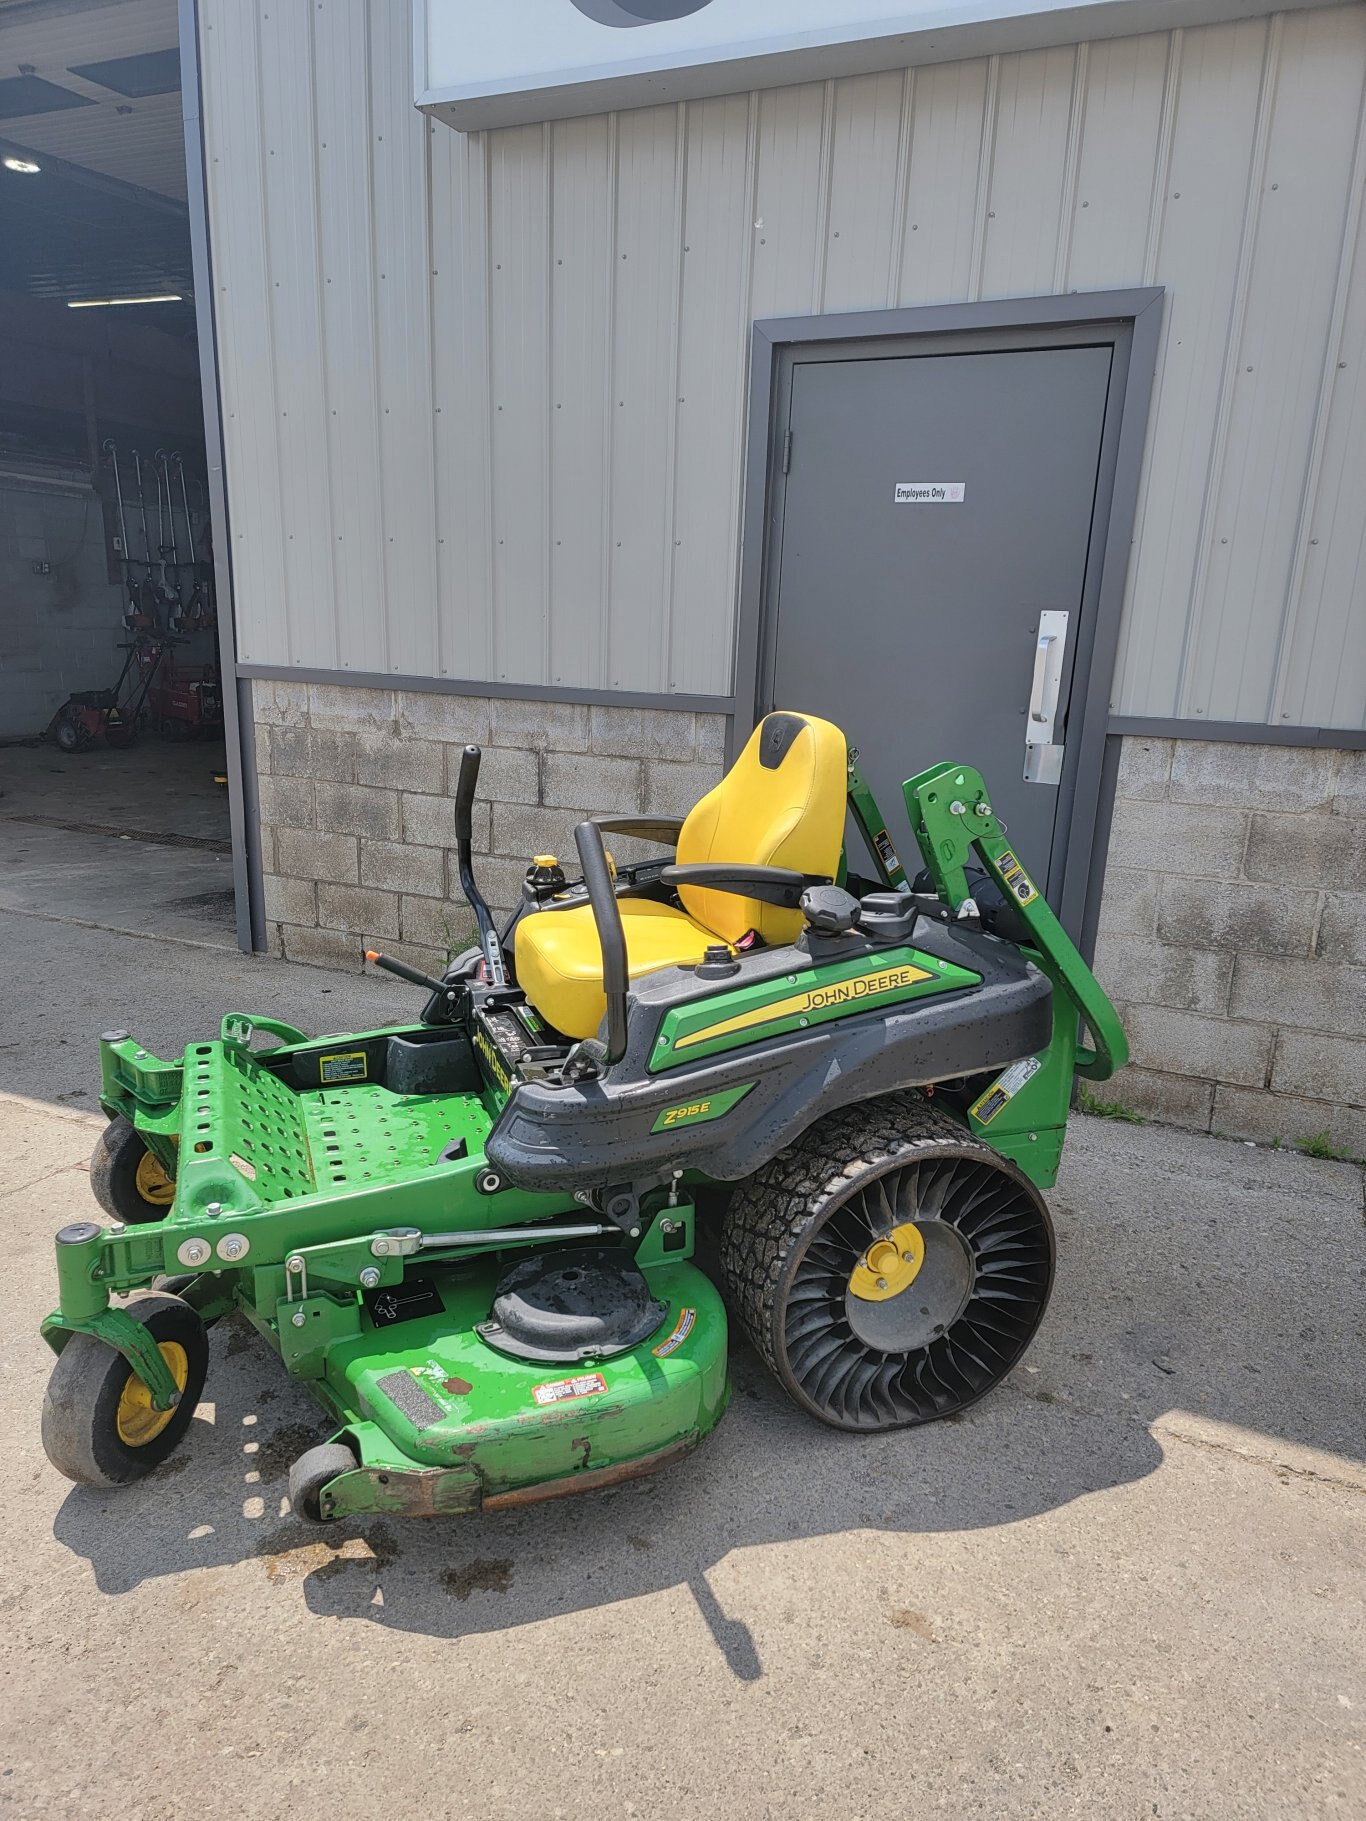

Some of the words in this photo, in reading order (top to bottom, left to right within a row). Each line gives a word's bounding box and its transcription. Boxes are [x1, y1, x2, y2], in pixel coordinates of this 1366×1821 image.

[896, 488, 930, 500] Employees
[931, 488, 946, 500] Only
[802, 986, 850, 1010] JOHN
[853, 971, 911, 996] DEERE
[663, 1101, 711, 1125] Z915E
